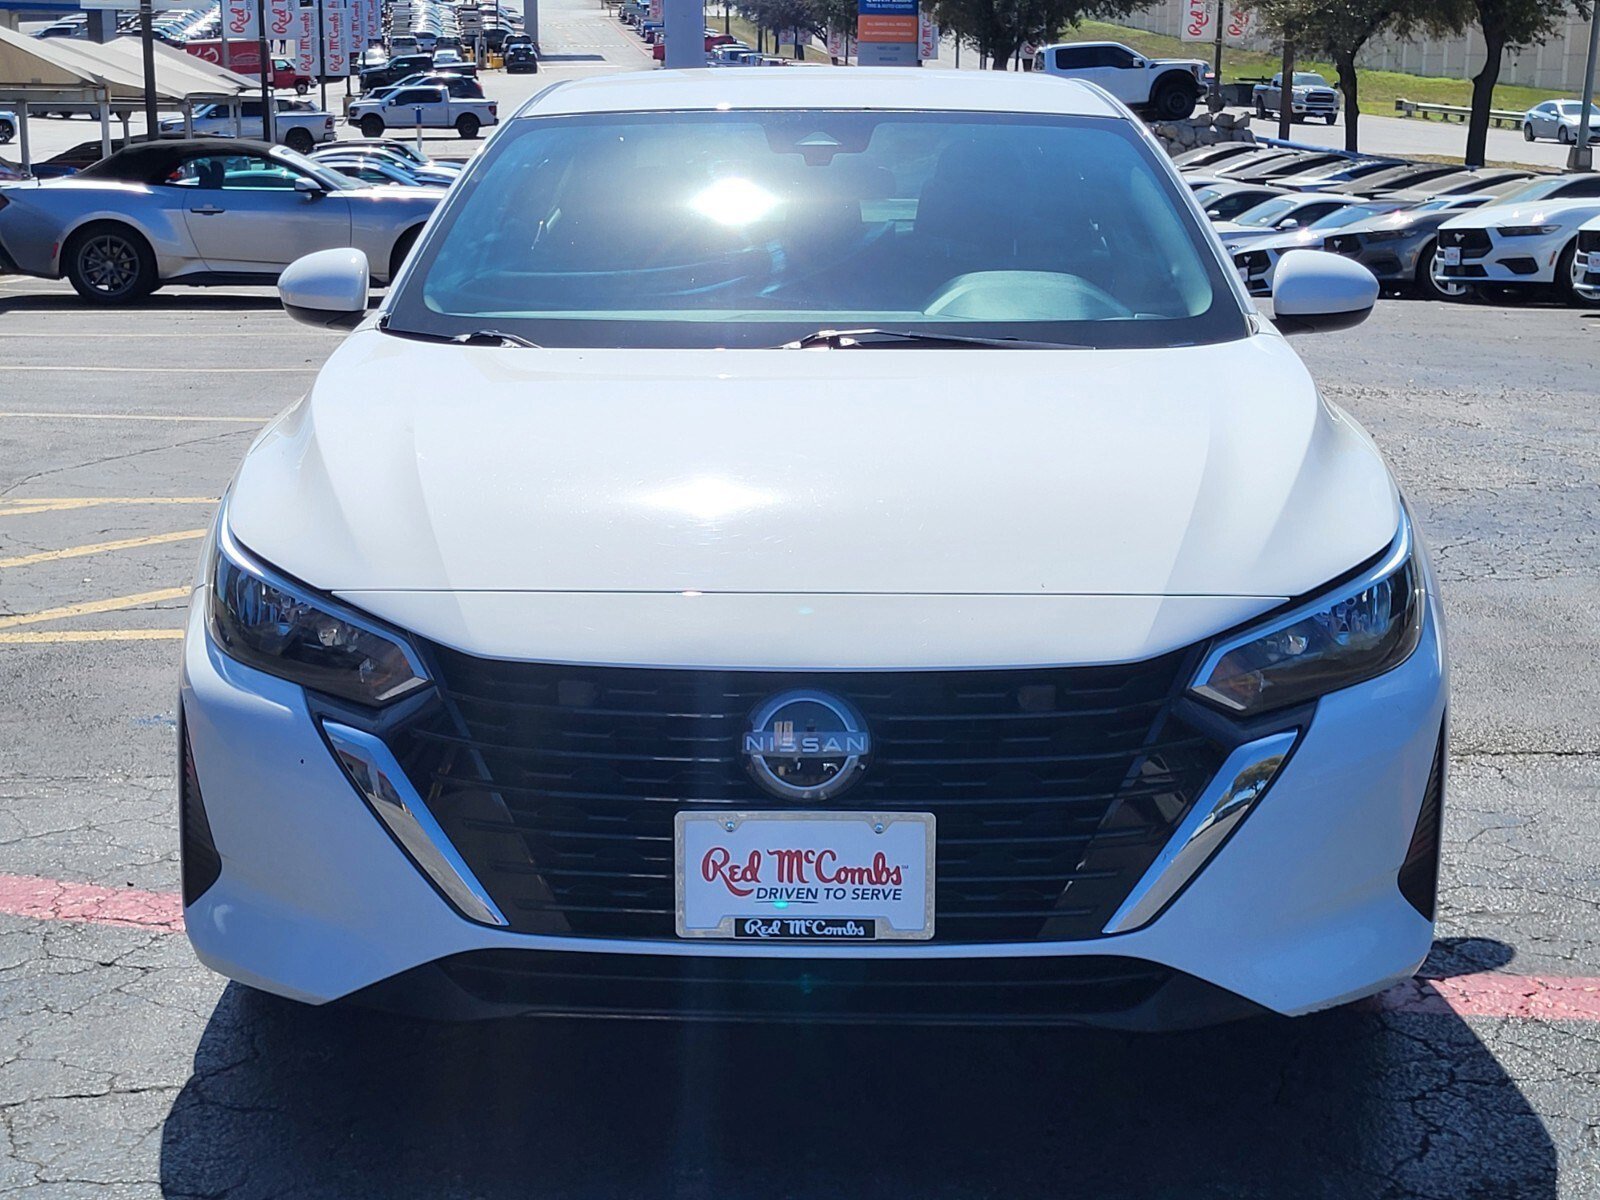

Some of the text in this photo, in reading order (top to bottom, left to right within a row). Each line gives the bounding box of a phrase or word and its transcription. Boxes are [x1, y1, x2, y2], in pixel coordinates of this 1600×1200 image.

[229, 8, 251, 34] Red
[271, 8, 293, 34] Red
[328, 12, 339, 51] McCombs
[1188, 10, 1209, 36] Red
[300, 54, 315, 72] Red
[328, 53, 344, 72] Red
[746, 736, 866, 753] NISSAN
[701, 846, 903, 896] Red McCombs
[756, 888, 903, 901] DRIVEN TO SERVE
[744, 918, 865, 938] Red McCombs
